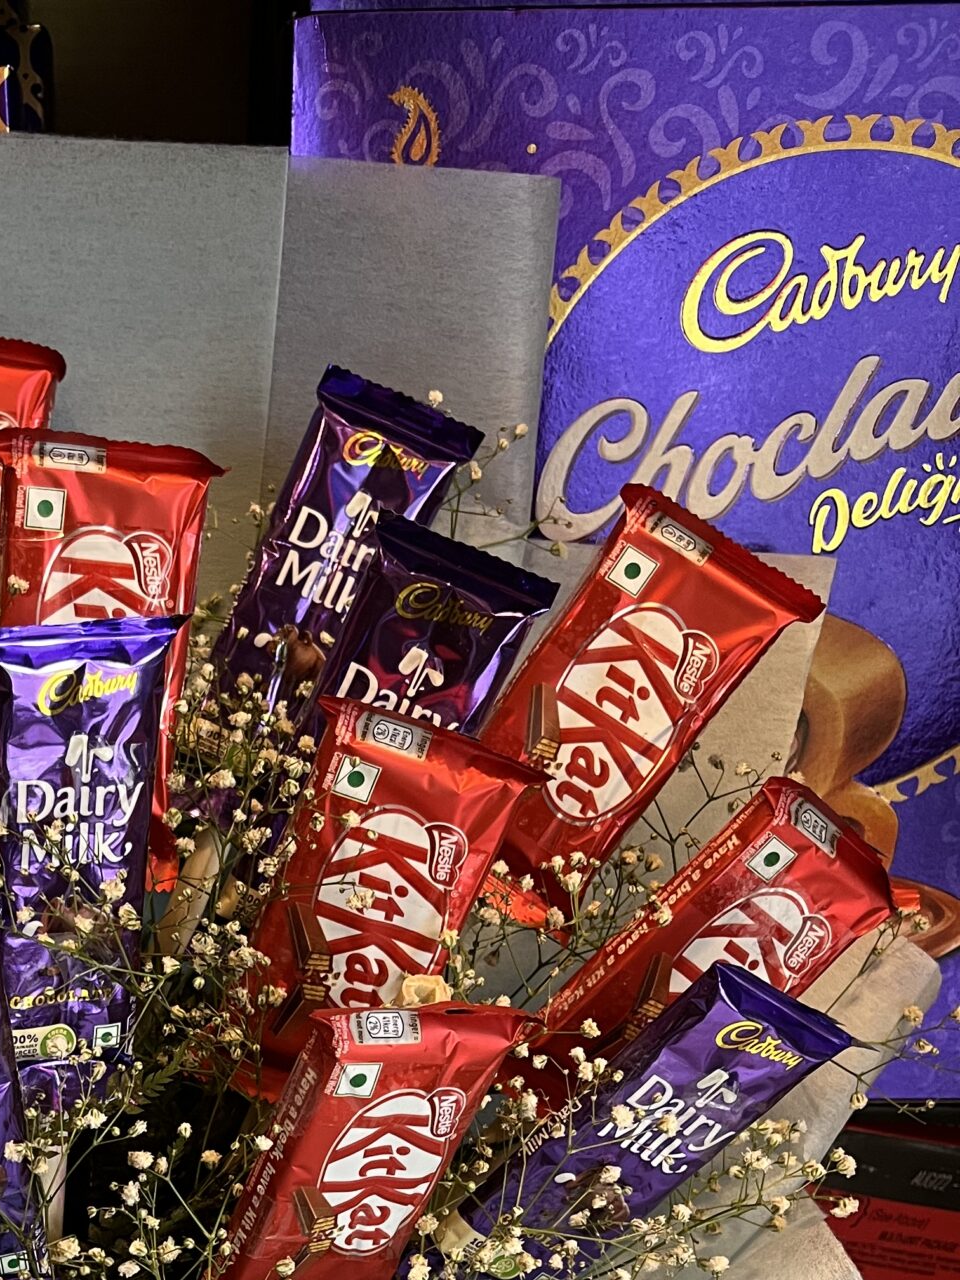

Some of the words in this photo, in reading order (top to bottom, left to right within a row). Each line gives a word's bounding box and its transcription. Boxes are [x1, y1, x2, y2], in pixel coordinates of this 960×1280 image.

[681, 229, 960, 354] Cadbury
[343, 431, 430, 480] Cadbury
[394, 582, 495, 636] Cadbury
[38, 669, 138, 717] Cadbury
[555, 616, 688, 817] KitKat
[397, 729, 410, 750] Energy
[16, 780, 144, 827] Dairy
[21, 823, 133, 873] Milk
[700, 832, 743, 873] Have
[582, 963, 608, 987] Kit
[368, 1020, 378, 1031] 2%
[381, 1016, 390, 1035] 41kcal
[390, 1014, 401, 1036] Energy
[714, 1019, 805, 1070] Cadbury
[289, 1066, 321, 1108] Have
[252, 1161, 278, 1196] have
[319, 1114, 444, 1247] KitKat
[238, 1207, 258, 1231] Kit
